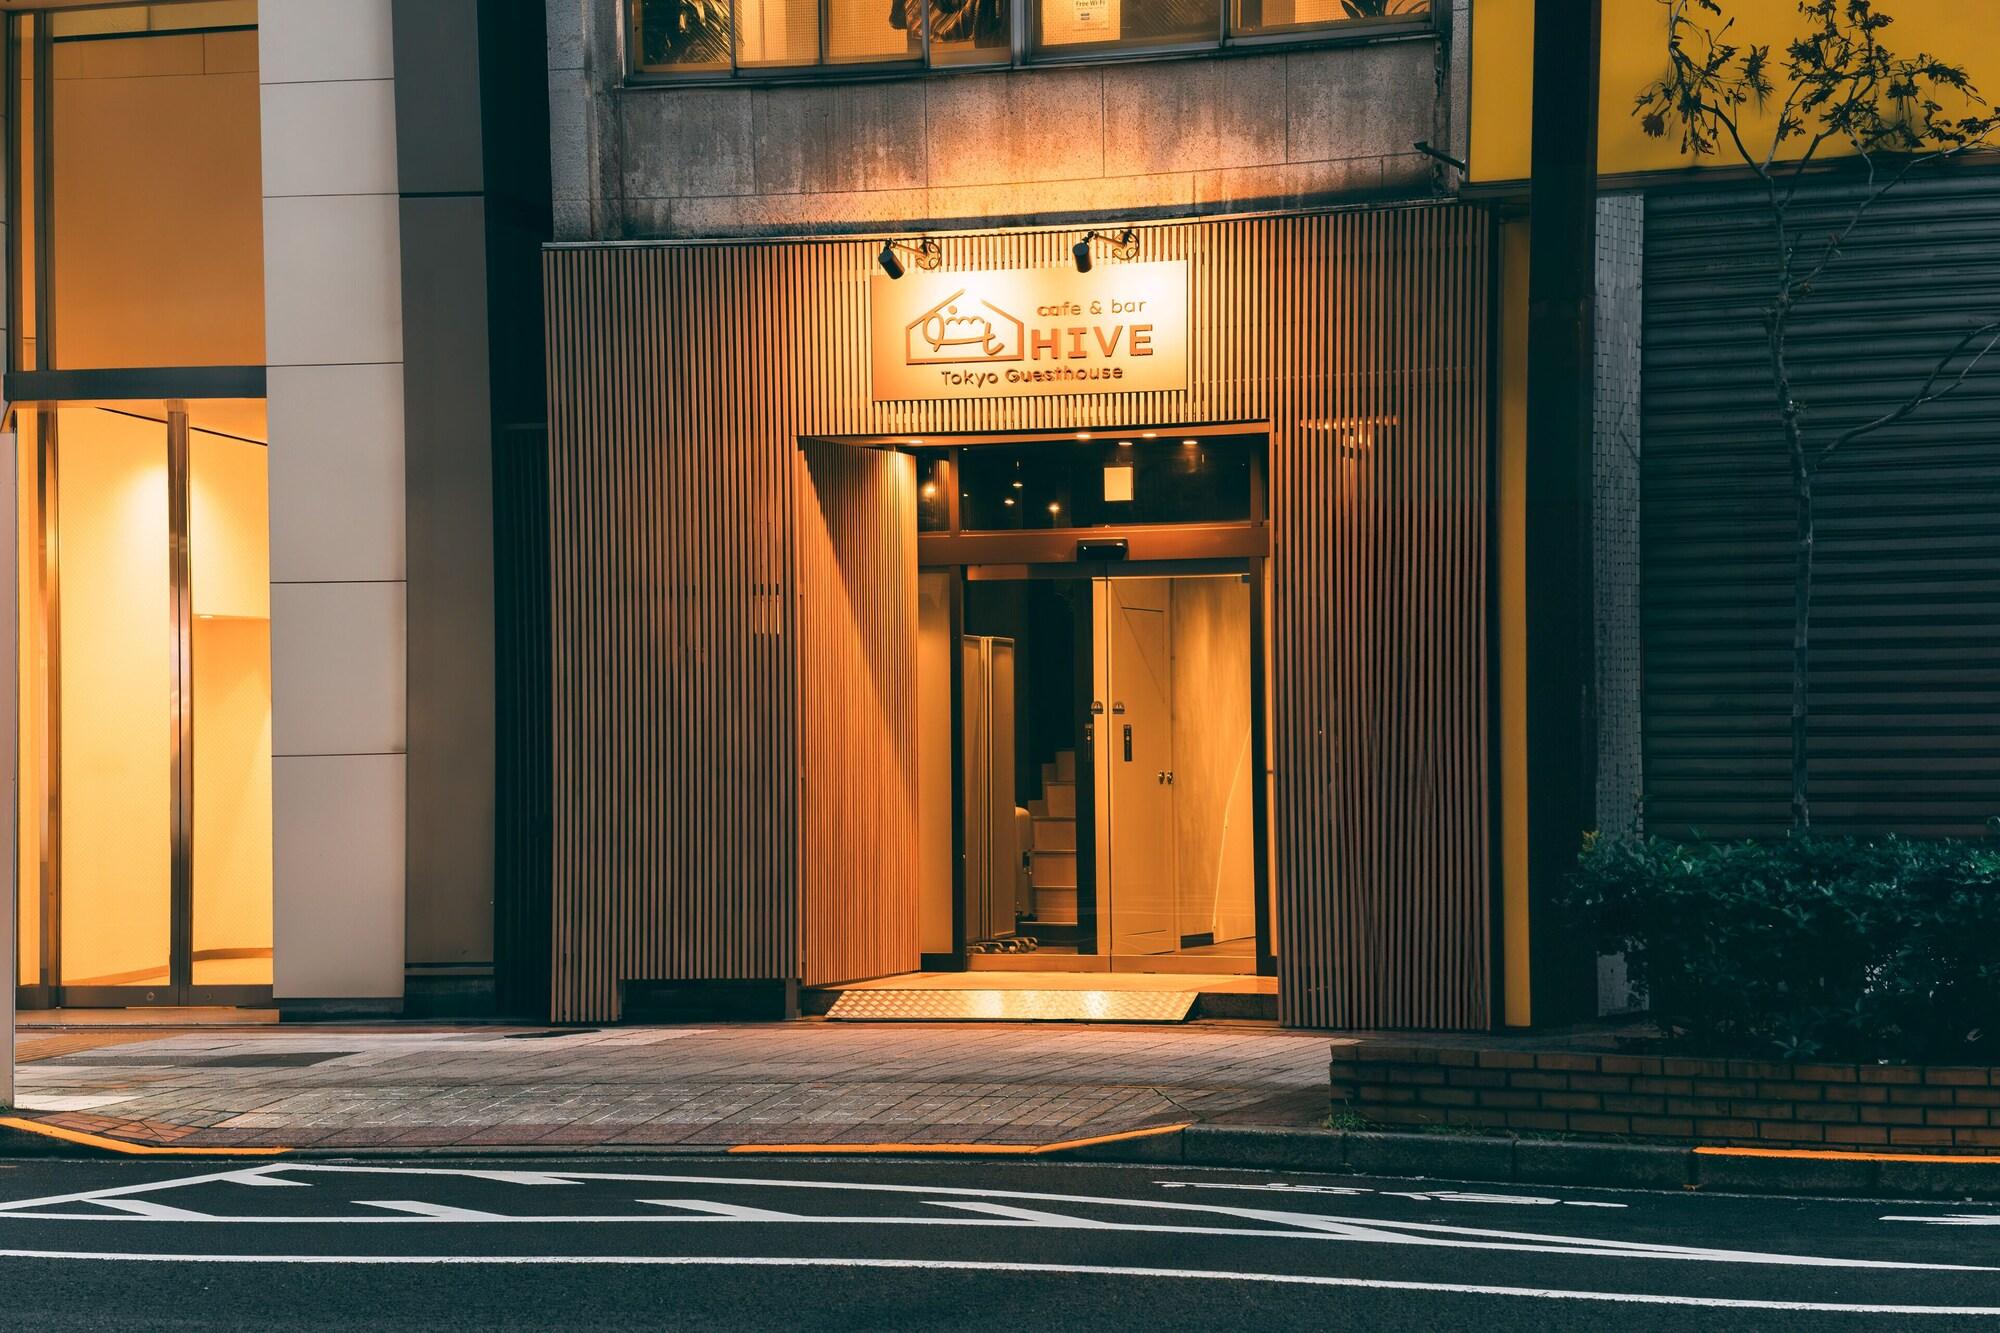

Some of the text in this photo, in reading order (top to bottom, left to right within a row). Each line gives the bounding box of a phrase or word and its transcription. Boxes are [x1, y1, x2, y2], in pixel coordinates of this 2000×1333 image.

[1037, 298, 1147, 316] cafe & bar
[1031, 324, 1153, 360] HIVE
[941, 366, 1123, 388] Tokyo Guesthouse
